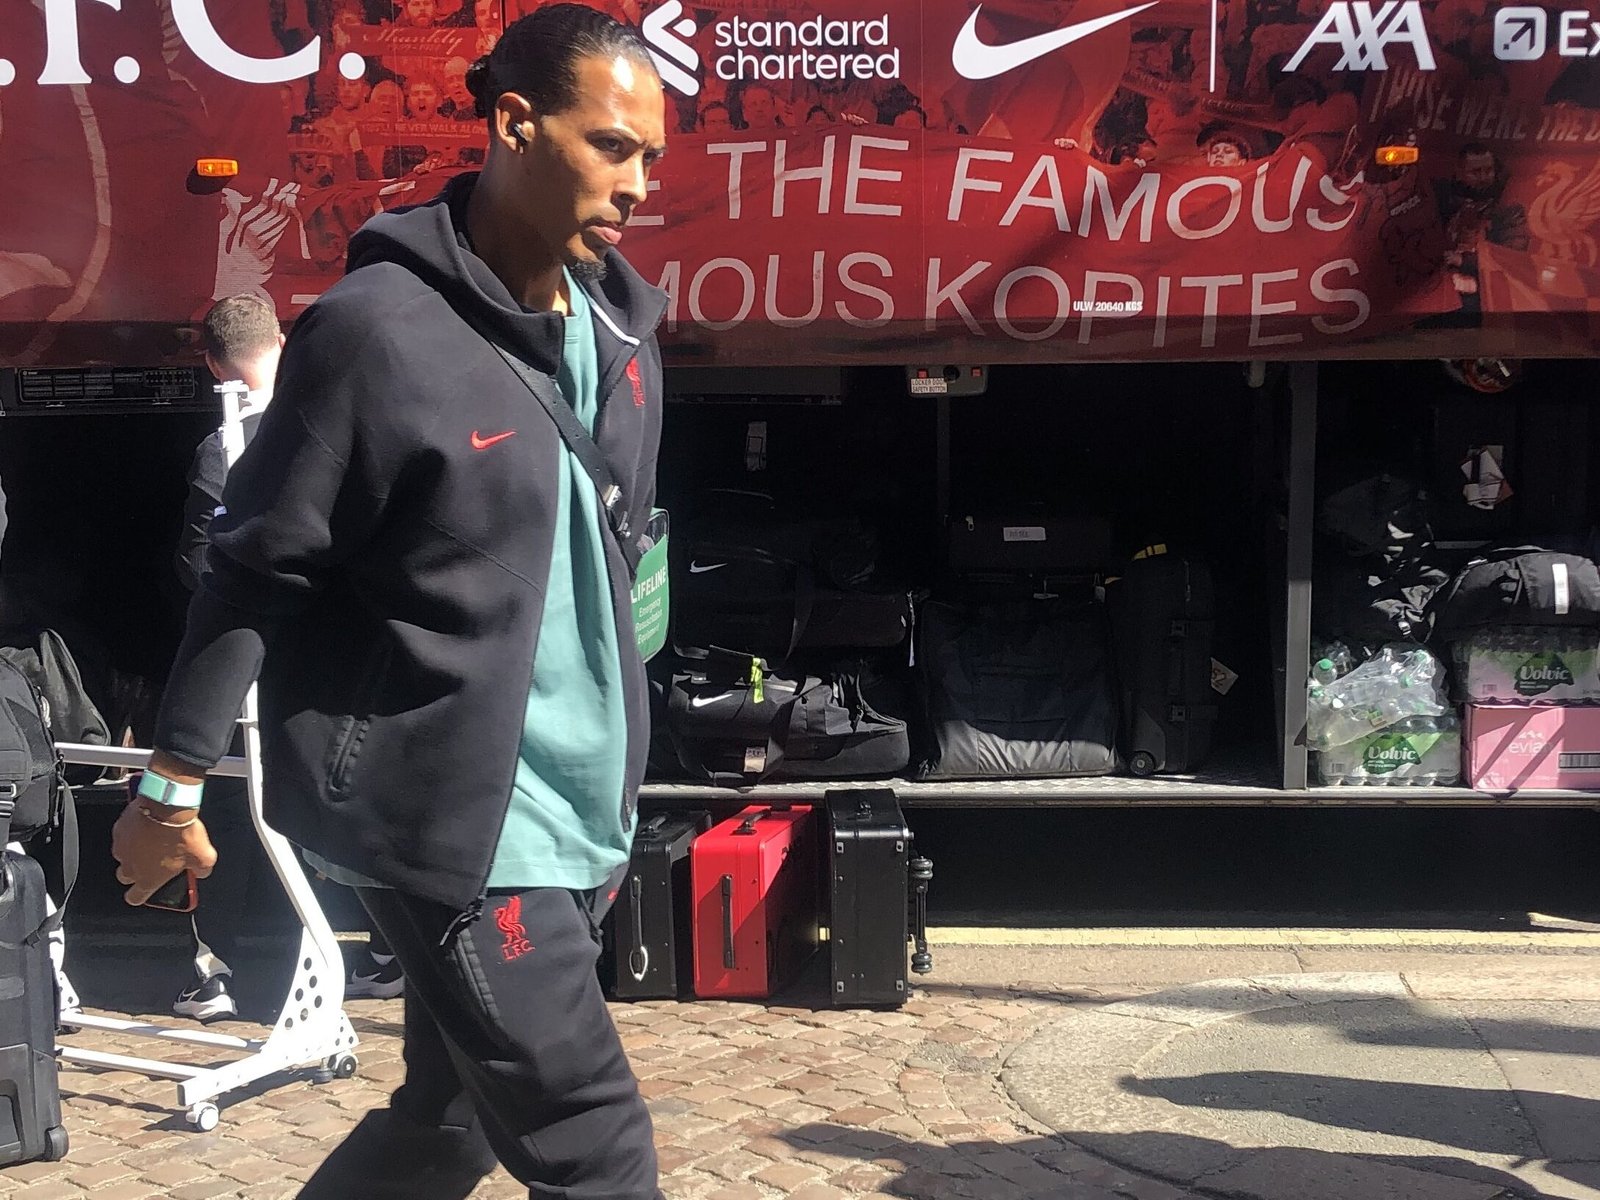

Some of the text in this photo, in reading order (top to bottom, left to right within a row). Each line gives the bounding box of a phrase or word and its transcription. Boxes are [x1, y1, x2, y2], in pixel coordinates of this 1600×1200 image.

[715, 14, 889, 47] standard
[1281, 1, 1437, 72] AXA
[715, 47, 900, 80] chartered
[707, 135, 909, 219] THE
[947, 147, 1365, 243] FAMOUS
[925, 256, 1371, 349] KOPITES
[1073, 300, 1093, 312] ULW
[1125, 301, 1143, 312] KGS
[631, 566, 666, 603] LIFELINE
[1520, 665, 1569, 680] Volvic
[1368, 746, 1417, 760] Volvic
